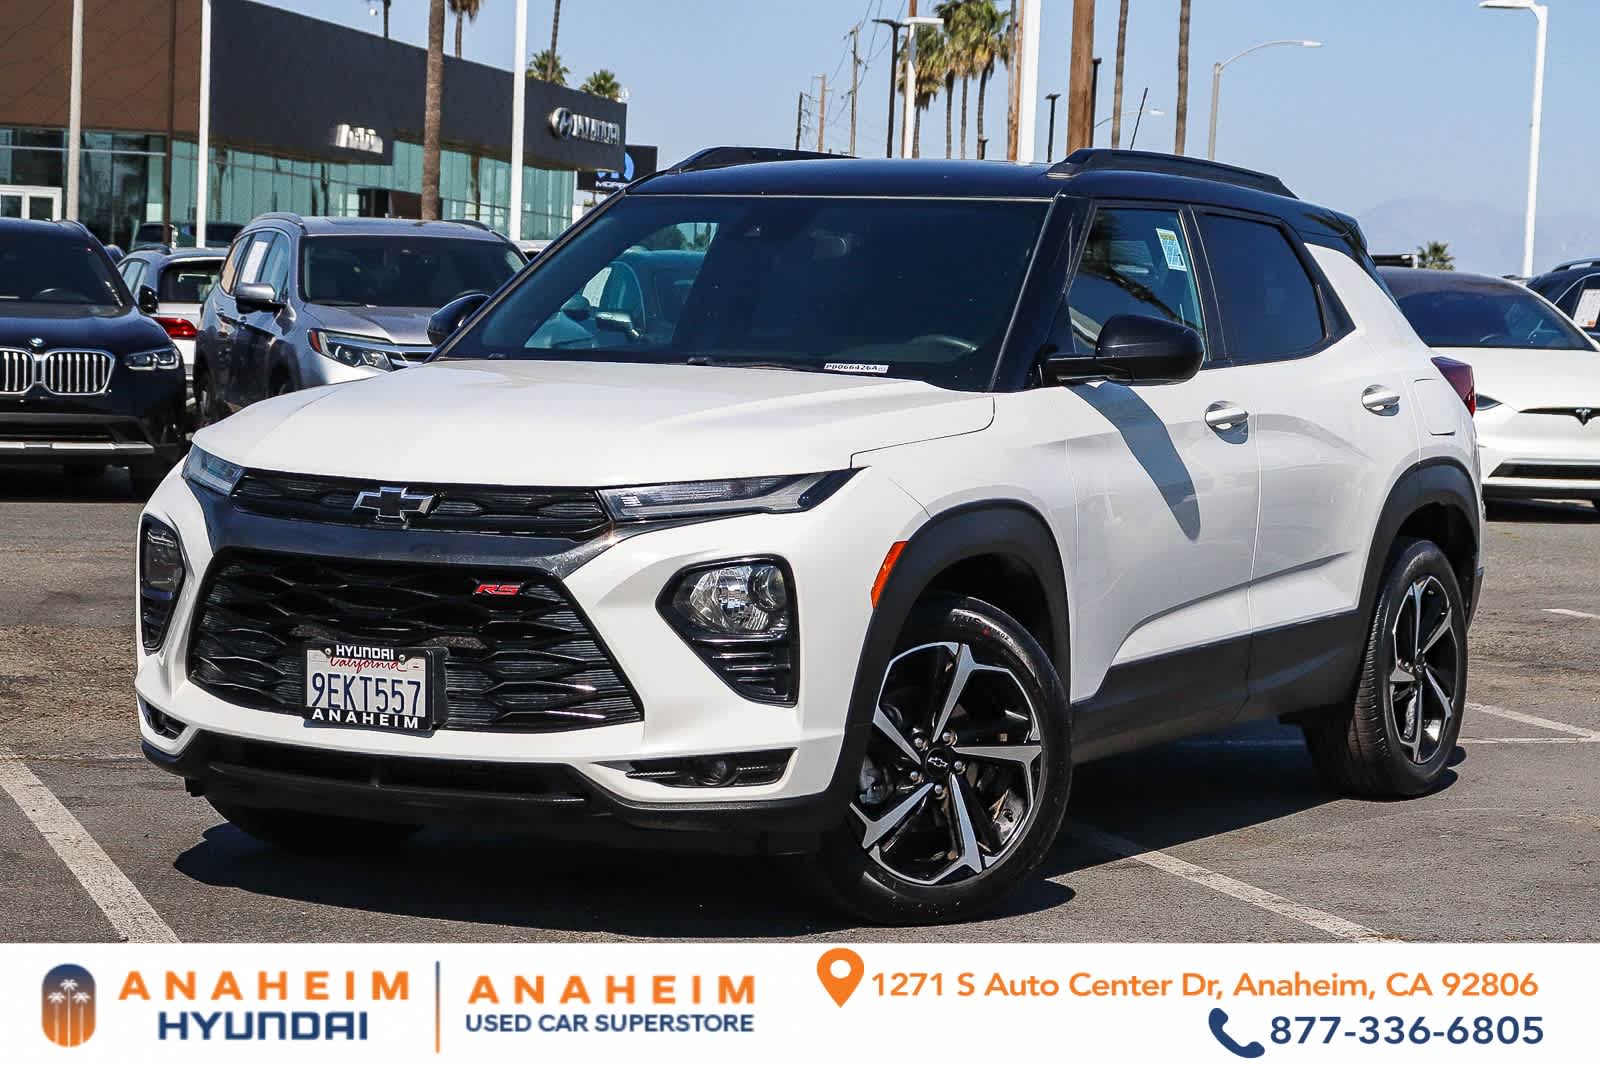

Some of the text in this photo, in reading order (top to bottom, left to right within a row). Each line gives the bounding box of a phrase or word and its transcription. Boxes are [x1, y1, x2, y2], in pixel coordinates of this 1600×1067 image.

[474, 584, 521, 596] RS
[335, 644, 394, 660] HYUNDAI
[311, 672, 421, 716] 9EKT557
[311, 708, 418, 729] ANAHEIM
